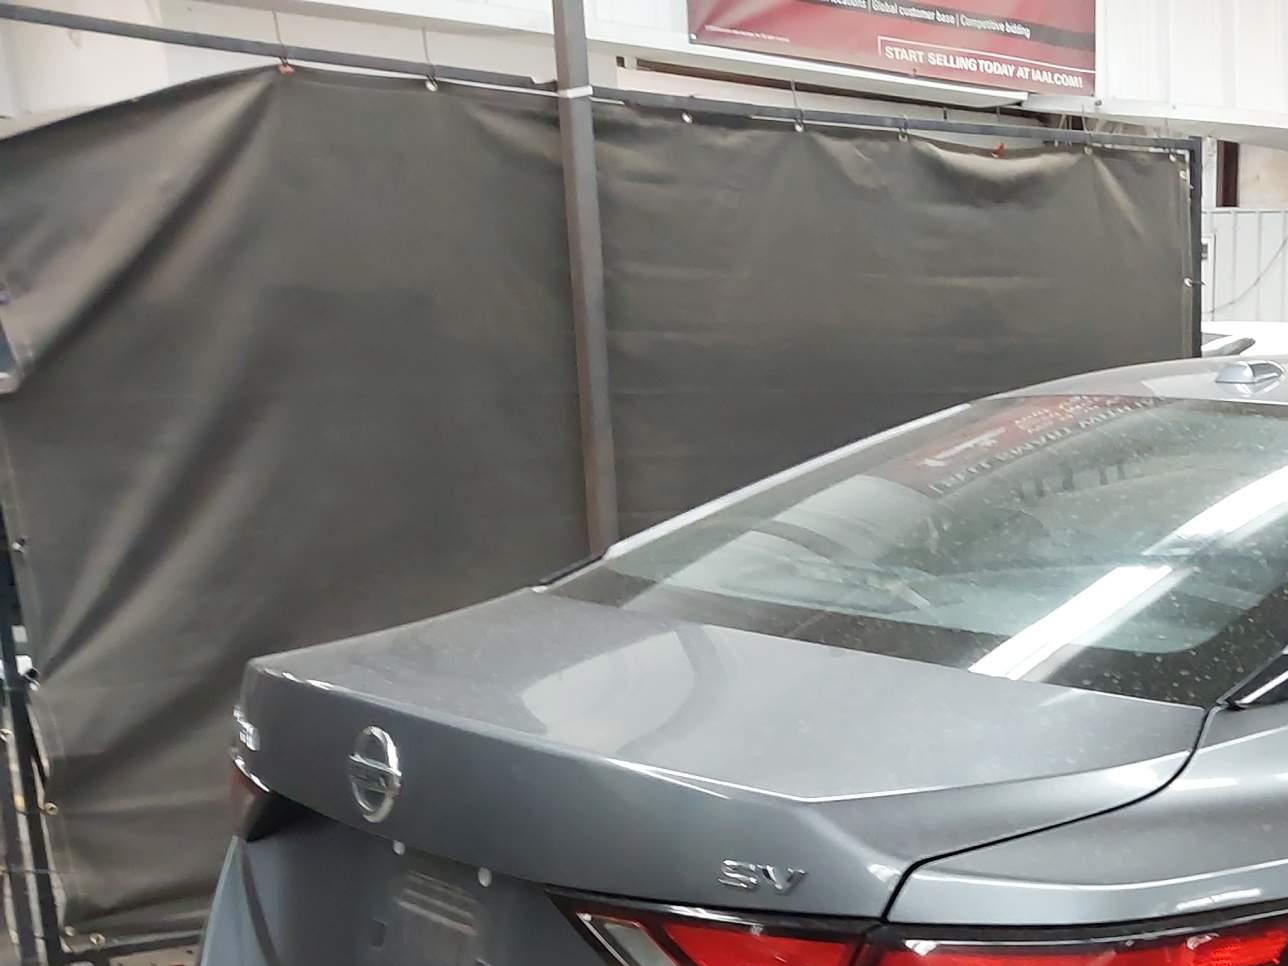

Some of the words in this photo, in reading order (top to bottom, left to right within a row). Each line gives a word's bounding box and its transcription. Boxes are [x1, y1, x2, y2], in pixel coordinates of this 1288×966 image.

[899, 3, 935, 21] customer
[936, 10, 955, 25] base
[885, 45, 924, 64] START
[927, 52, 977, 72] SELLING
[978, 59, 1015, 78] TODAY
[1016, 68, 1032, 81] AT
[718, 859, 808, 894] SV
